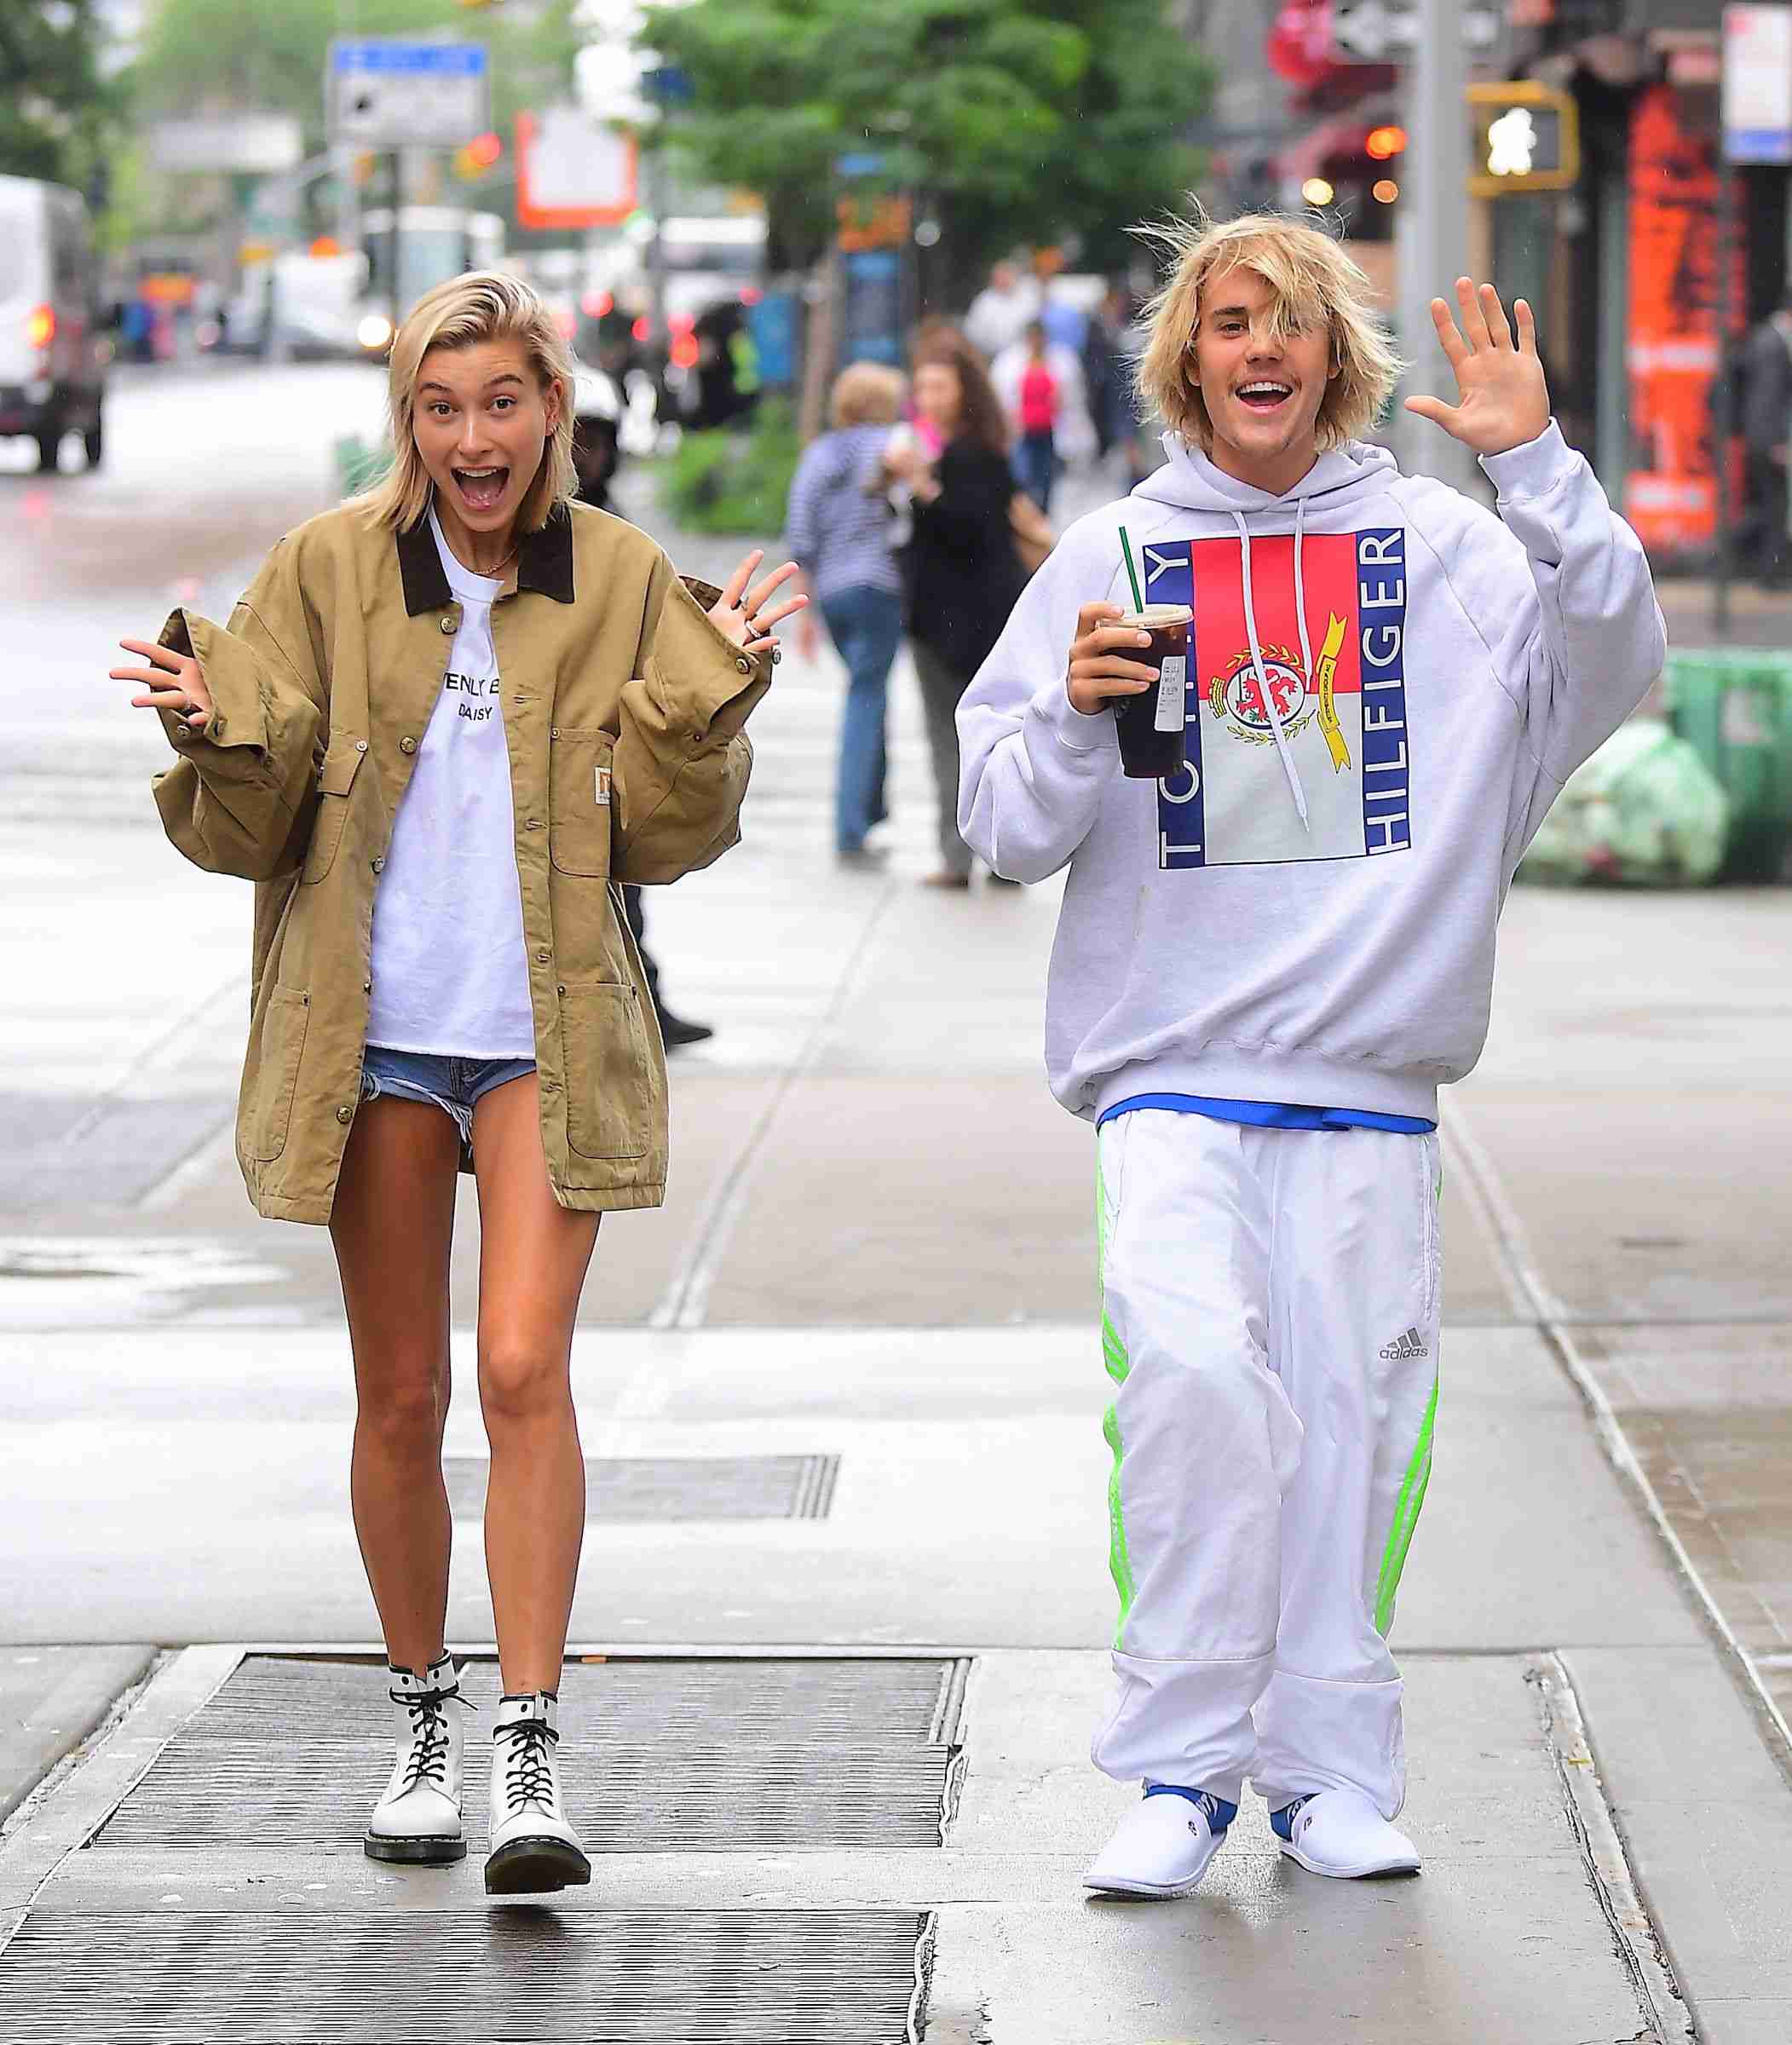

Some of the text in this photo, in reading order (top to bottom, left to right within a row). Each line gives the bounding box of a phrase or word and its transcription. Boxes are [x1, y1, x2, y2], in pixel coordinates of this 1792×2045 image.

[443, 671, 486, 696] ENLY
[1359, 529, 1409, 855] HILFIGER
[458, 703, 493, 721] DAISY
[1144, 545, 1201, 867] TOY
[1380, 1346, 1428, 1360] adidas
